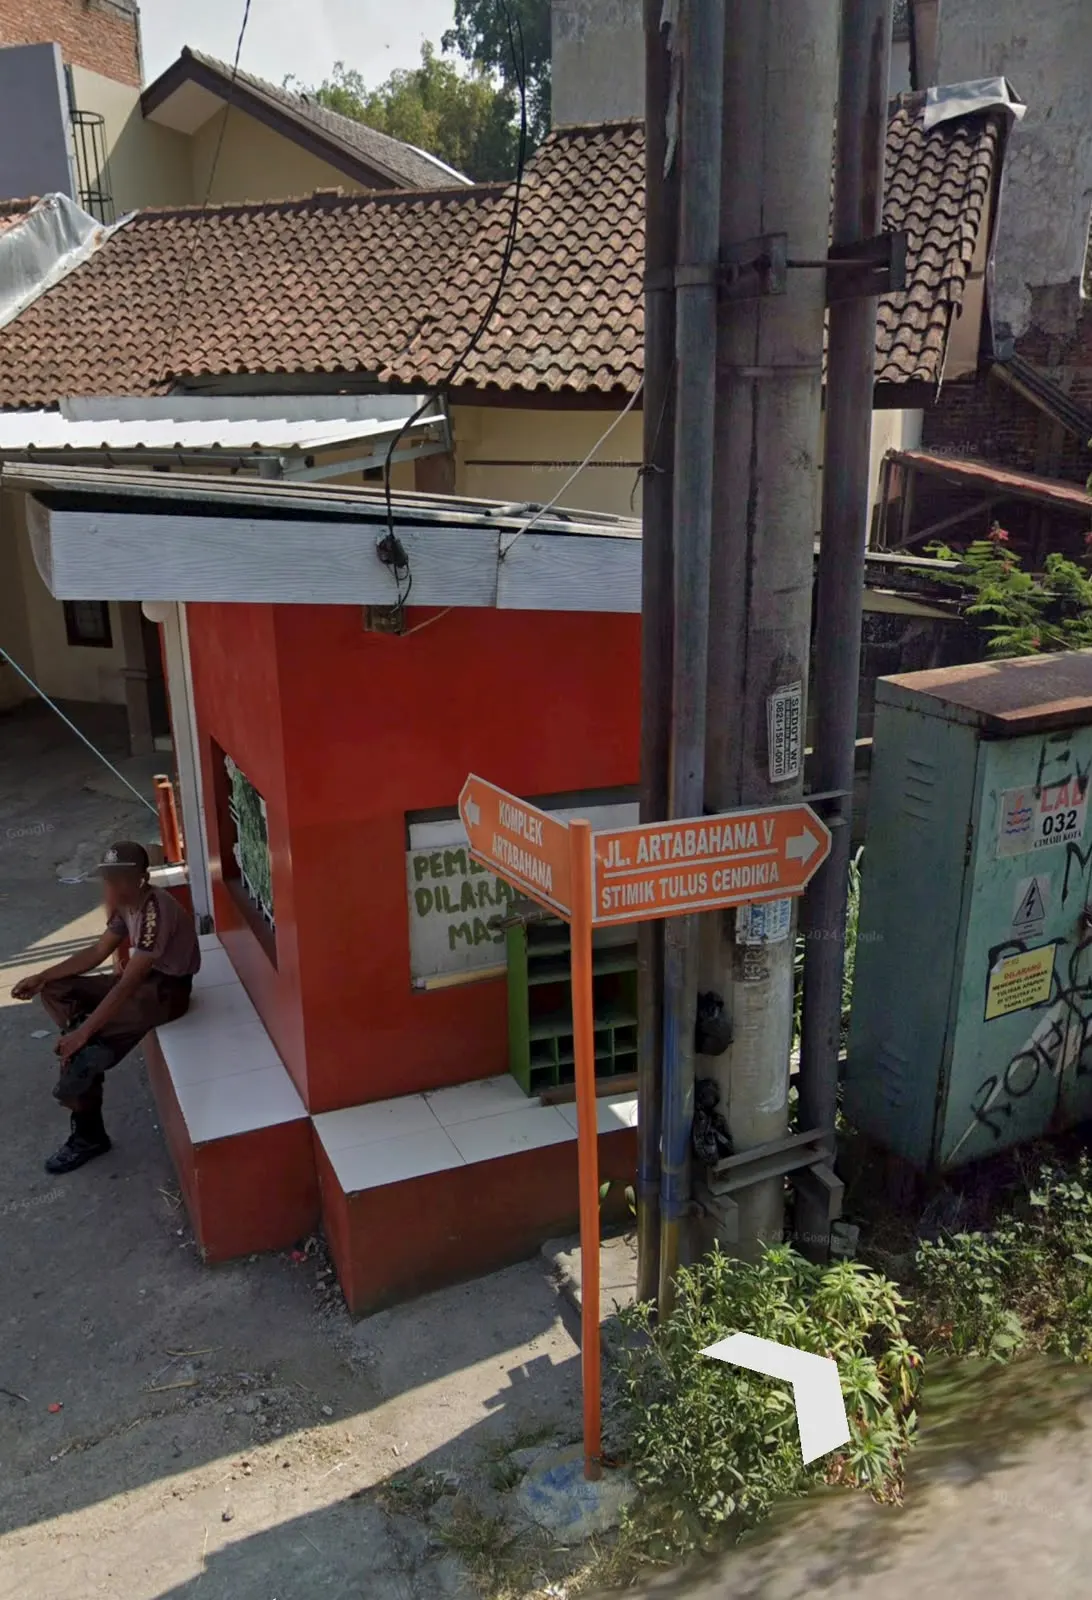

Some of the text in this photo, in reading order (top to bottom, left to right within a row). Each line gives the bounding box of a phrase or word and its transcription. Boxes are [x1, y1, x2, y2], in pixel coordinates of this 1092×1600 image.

[789, 698, 800, 770] SEDOT WC
[499, 799, 543, 848] KOMPLEK
[603, 818, 776, 868] JL. ARTABAHANA V
[1042, 810, 1078, 836] 032
[1062, 830, 1082, 842] KOTA
[492, 831, 553, 892] ARTABAHANA
[601, 861, 779, 909] STIMIK TULUS CENDIKIA
